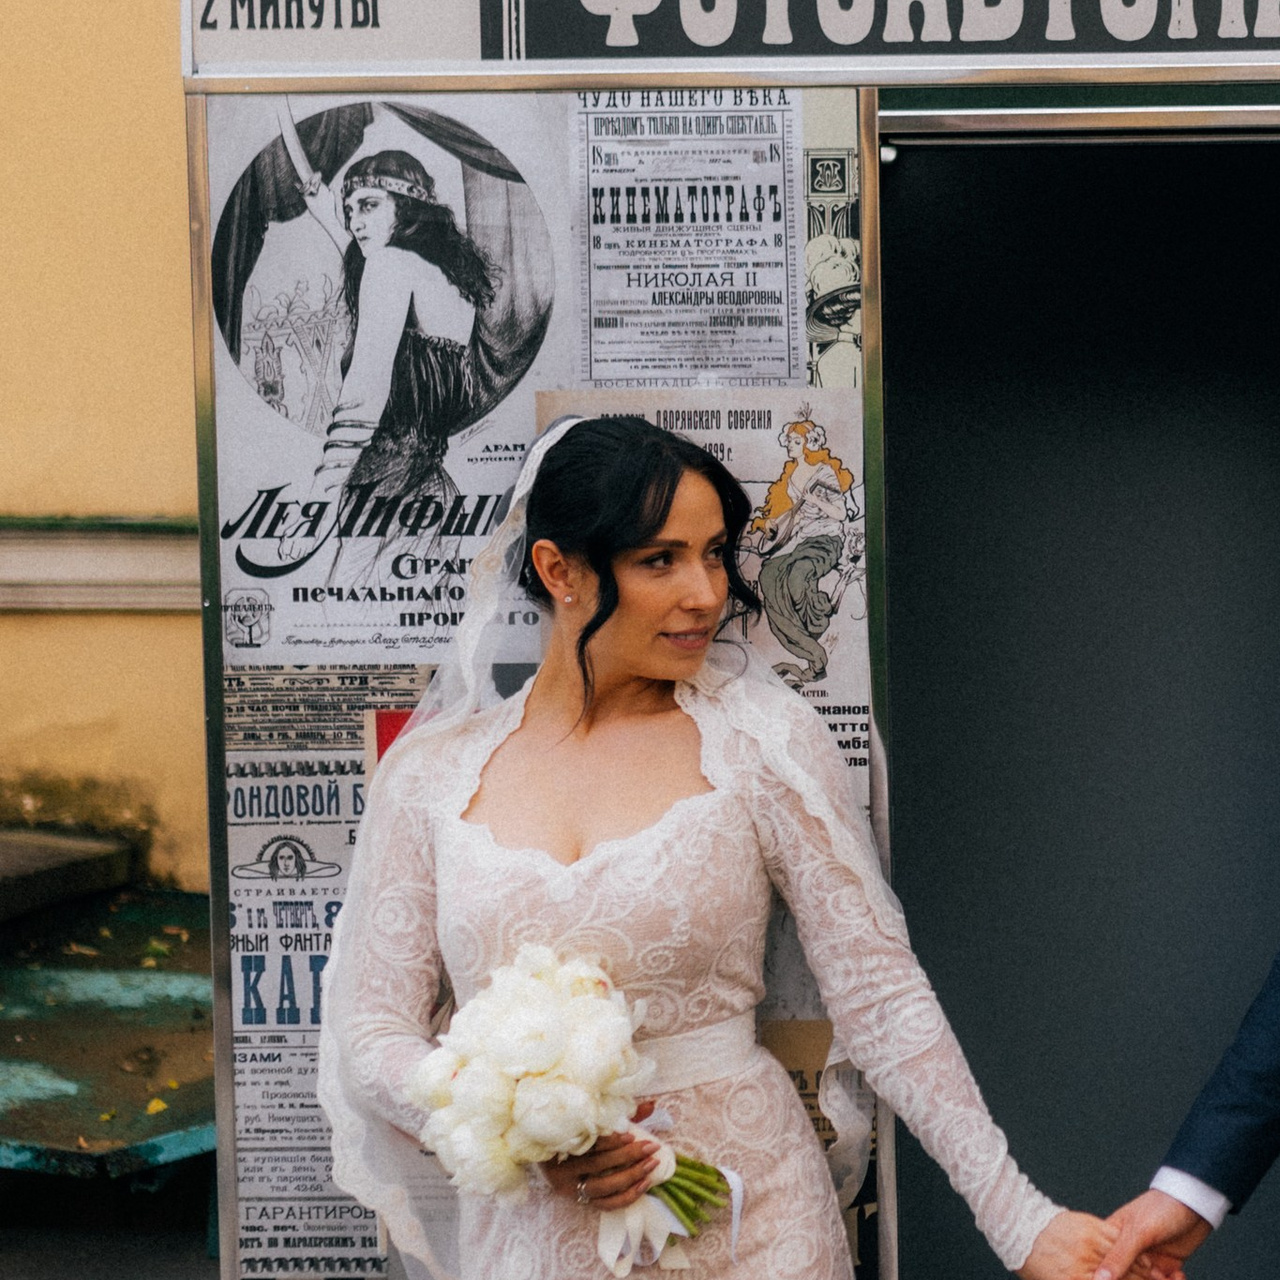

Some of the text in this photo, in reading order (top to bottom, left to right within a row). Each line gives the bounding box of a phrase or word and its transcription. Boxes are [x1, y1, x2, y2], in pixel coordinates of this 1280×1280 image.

[640, 90, 724, 107] НАШЕГО
[592, 145, 603, 166] 18
[769, 143, 781, 163] 18
[592, 185, 782, 224] КИНЕМАТОГРАФЪ
[727, 224, 762, 232] СЦЕНЫ
[593, 233, 783, 250] 18 КИНЕМАТОГРАФА 18
[626, 272, 734, 288] НИКОЛАЯ
[651, 292, 715, 307] АЛЕКСАНДРЫ
[482, 443, 526, 453] ДРАМ
[338, 676, 369, 686] ТРИ
[227, 779, 340, 819] ОНДОВОЙ
[234, 887, 347, 897] СТРАИВАЕТС
